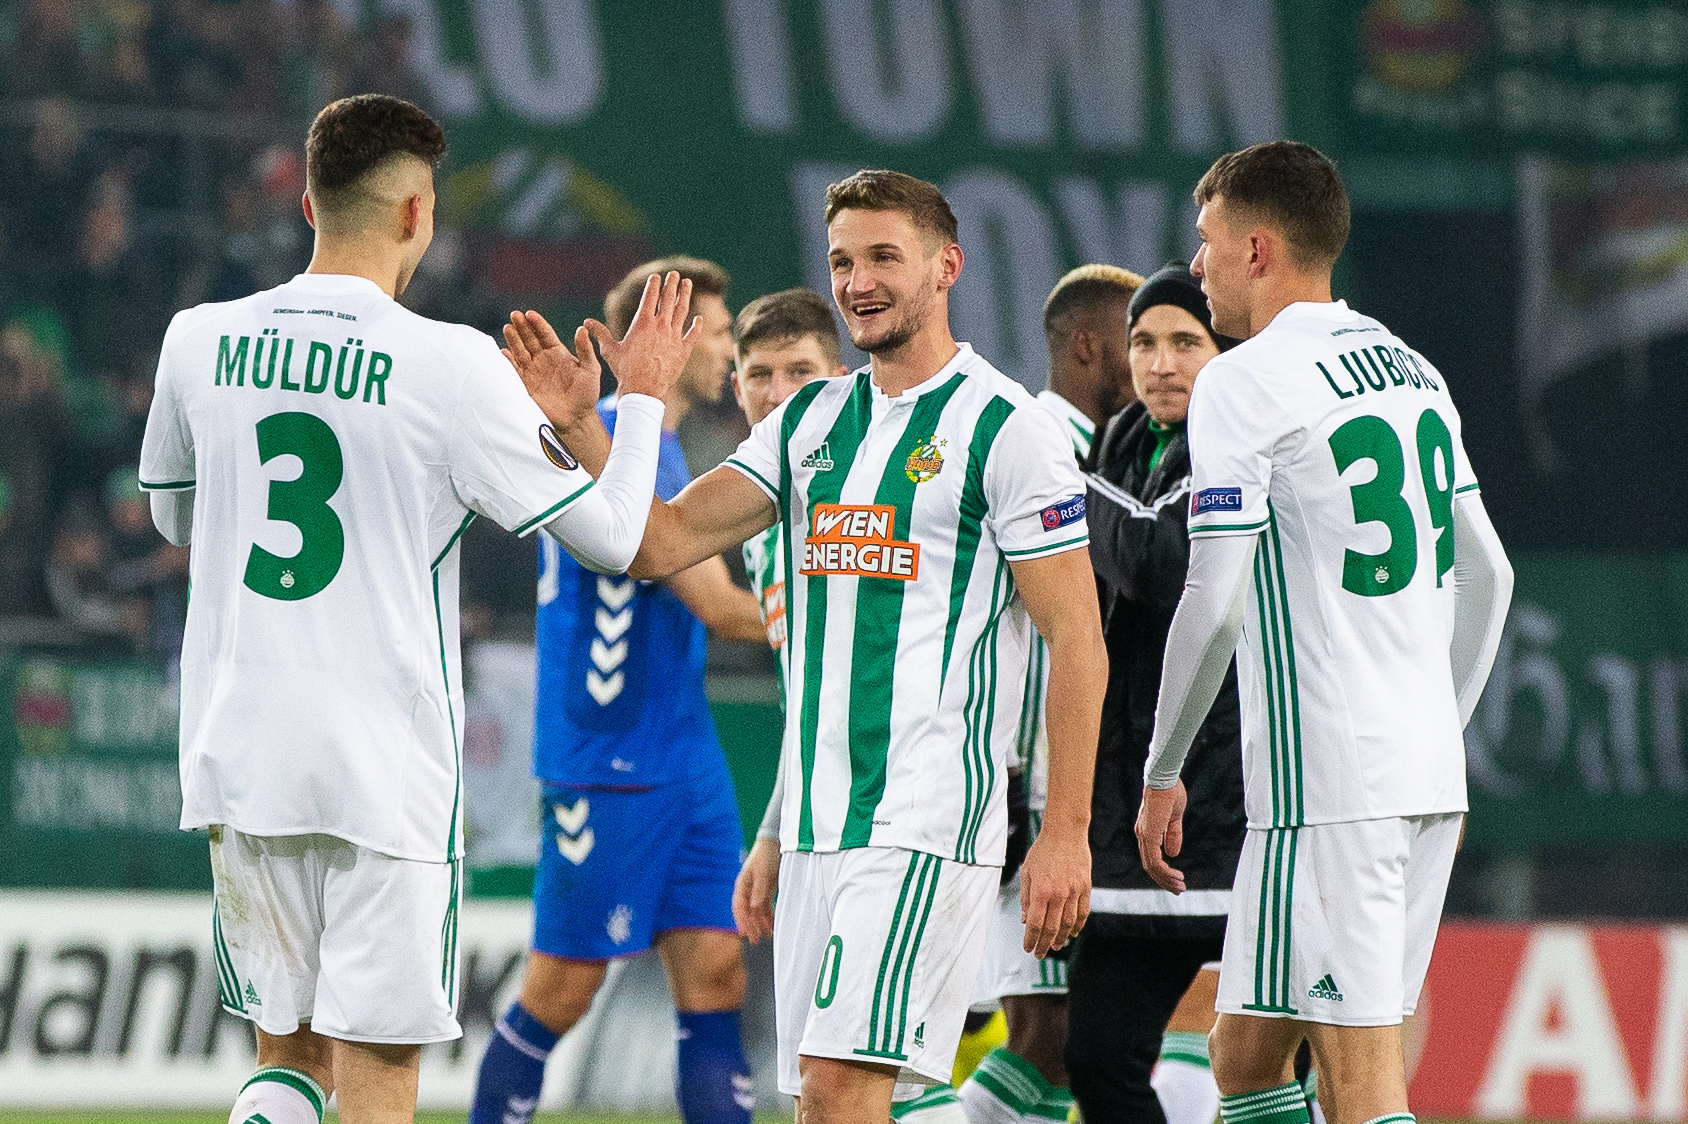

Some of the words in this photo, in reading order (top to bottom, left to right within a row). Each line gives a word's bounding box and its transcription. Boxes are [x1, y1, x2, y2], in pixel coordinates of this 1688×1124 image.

[214, 328, 393, 406] MÜLDÜR
[801, 457, 834, 471] adidas
[243, 411, 345, 601] 3
[1328, 408, 1455, 597] 39
[815, 510, 890, 539] WIEN
[801, 543, 914, 576] ENERGIE
[1308, 989, 1343, 1002] adidas
